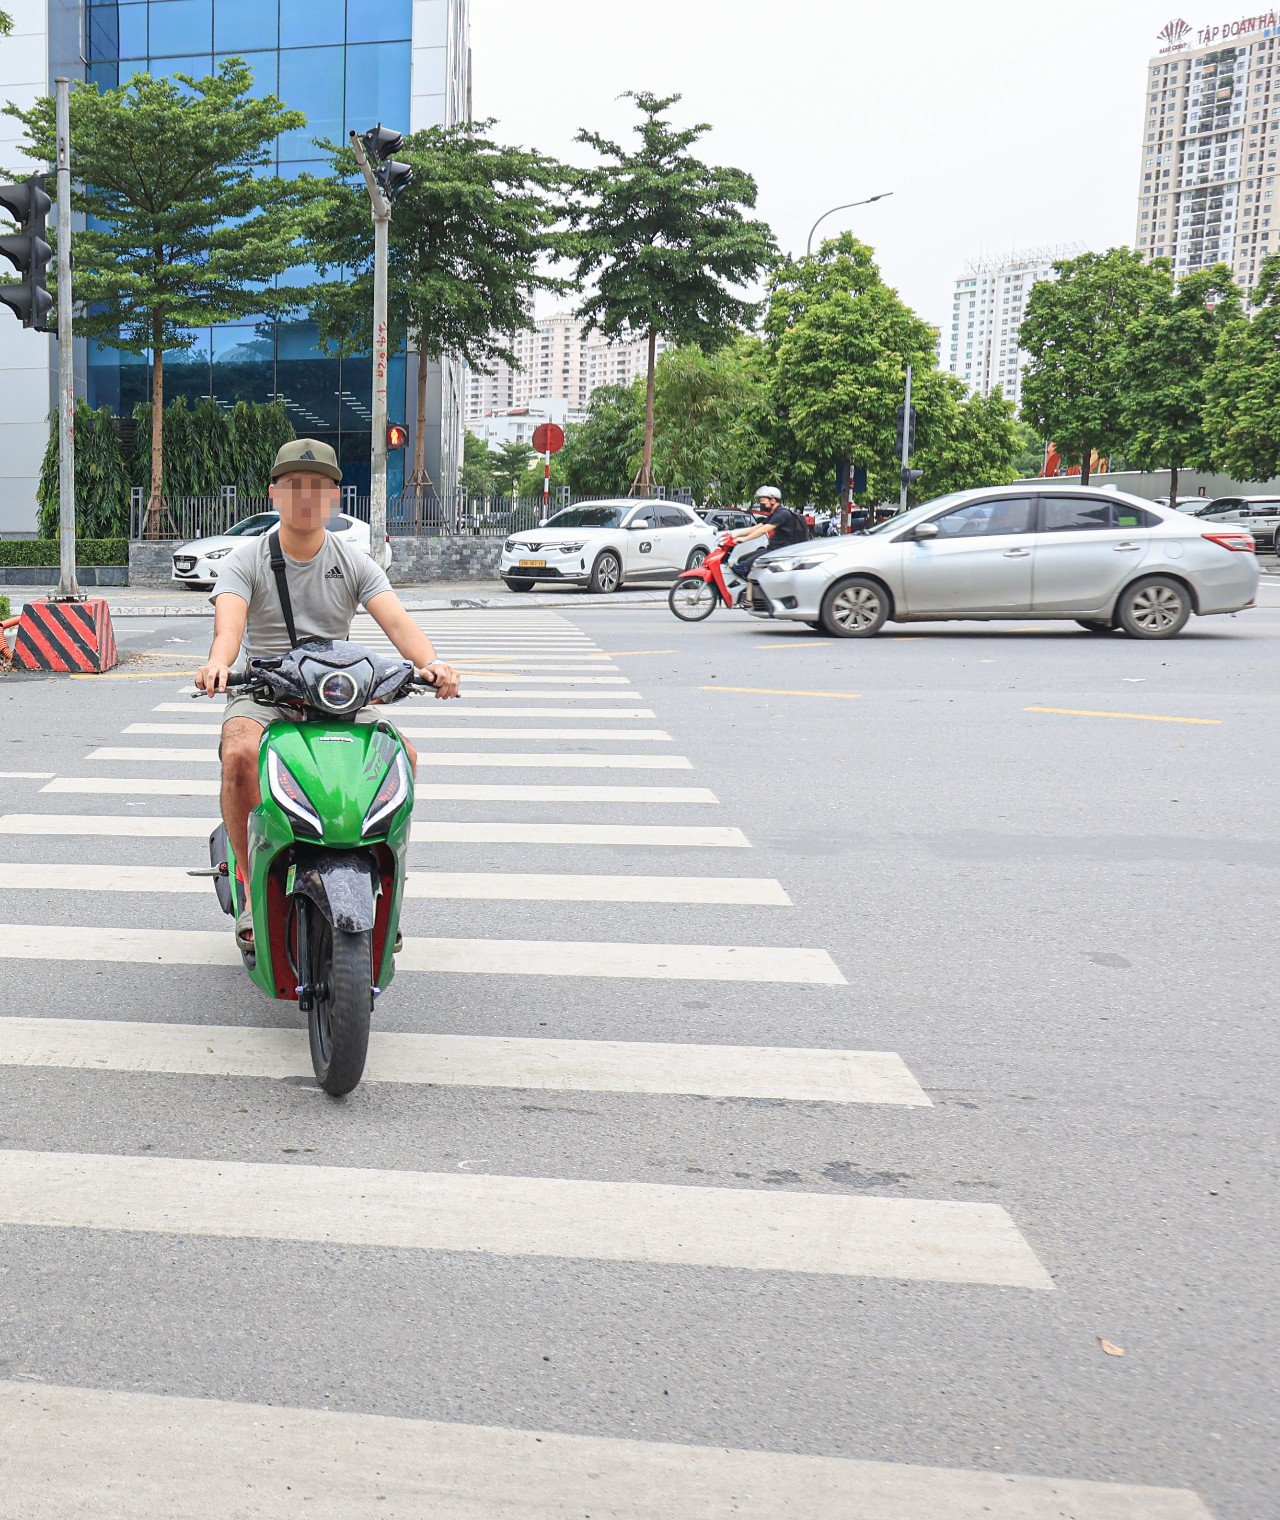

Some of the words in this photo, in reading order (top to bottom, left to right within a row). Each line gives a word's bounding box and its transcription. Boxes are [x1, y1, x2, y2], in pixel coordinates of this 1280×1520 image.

[1198, 25, 1219, 46] TẬP
[1222, 16, 1255, 38] ĐOÀN
[1259, 9, 1277, 28] HÀ
